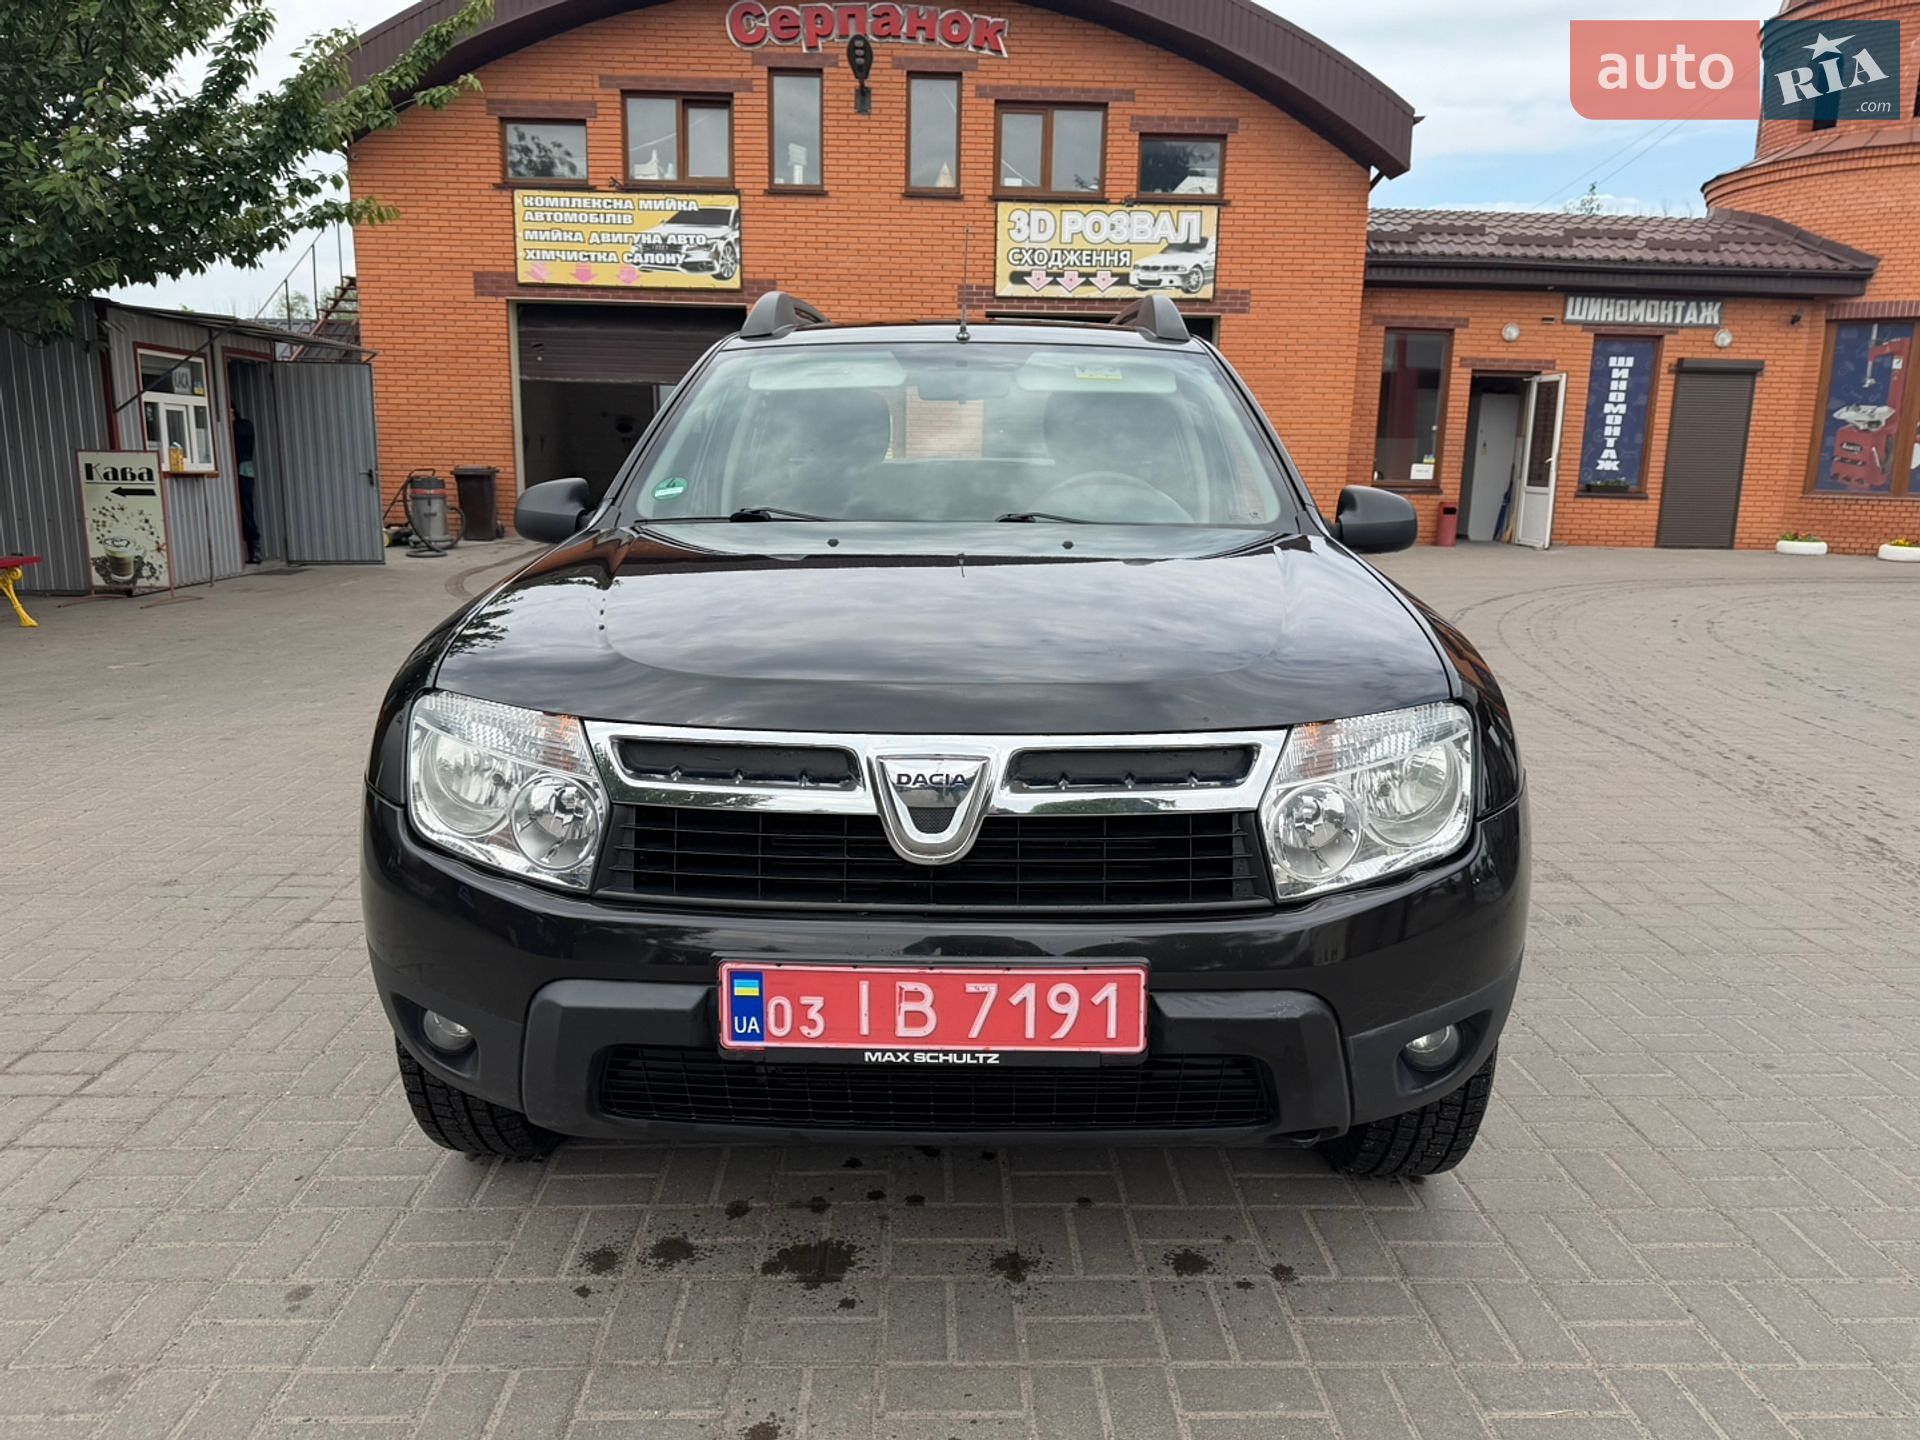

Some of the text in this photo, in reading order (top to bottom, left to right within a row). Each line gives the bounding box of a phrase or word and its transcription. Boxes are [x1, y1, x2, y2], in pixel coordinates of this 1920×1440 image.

[726, 2, 1009, 57] Серпанок
[523, 195, 699, 212] КОМПЛЕКСНА МИЙКА
[523, 212, 633, 225] АВТОМОБІЛІВ
[1008, 209, 1202, 245] 3D РОЗВАЛ
[523, 229, 707, 246] МИЙКА ДВИГУНА АВТО
[523, 249, 686, 265] ХІМЧИСТКА САЛОНУ
[1007, 247, 1132, 269] СХОДЖЕННЯ
[1565, 295, 1723, 326] ШИНОМОНТАЖ
[1596, 356, 1635, 472] ШИНОМОНТАЖ
[84, 462, 155, 482] Кава
[896, 773, 968, 787] DACIA
[767, 996, 825, 1038] 03
[965, 982, 1119, 1040] 7191
[733, 1016, 760, 1034] UA
[864, 1051, 1000, 1065] MAX SCHULTZ
